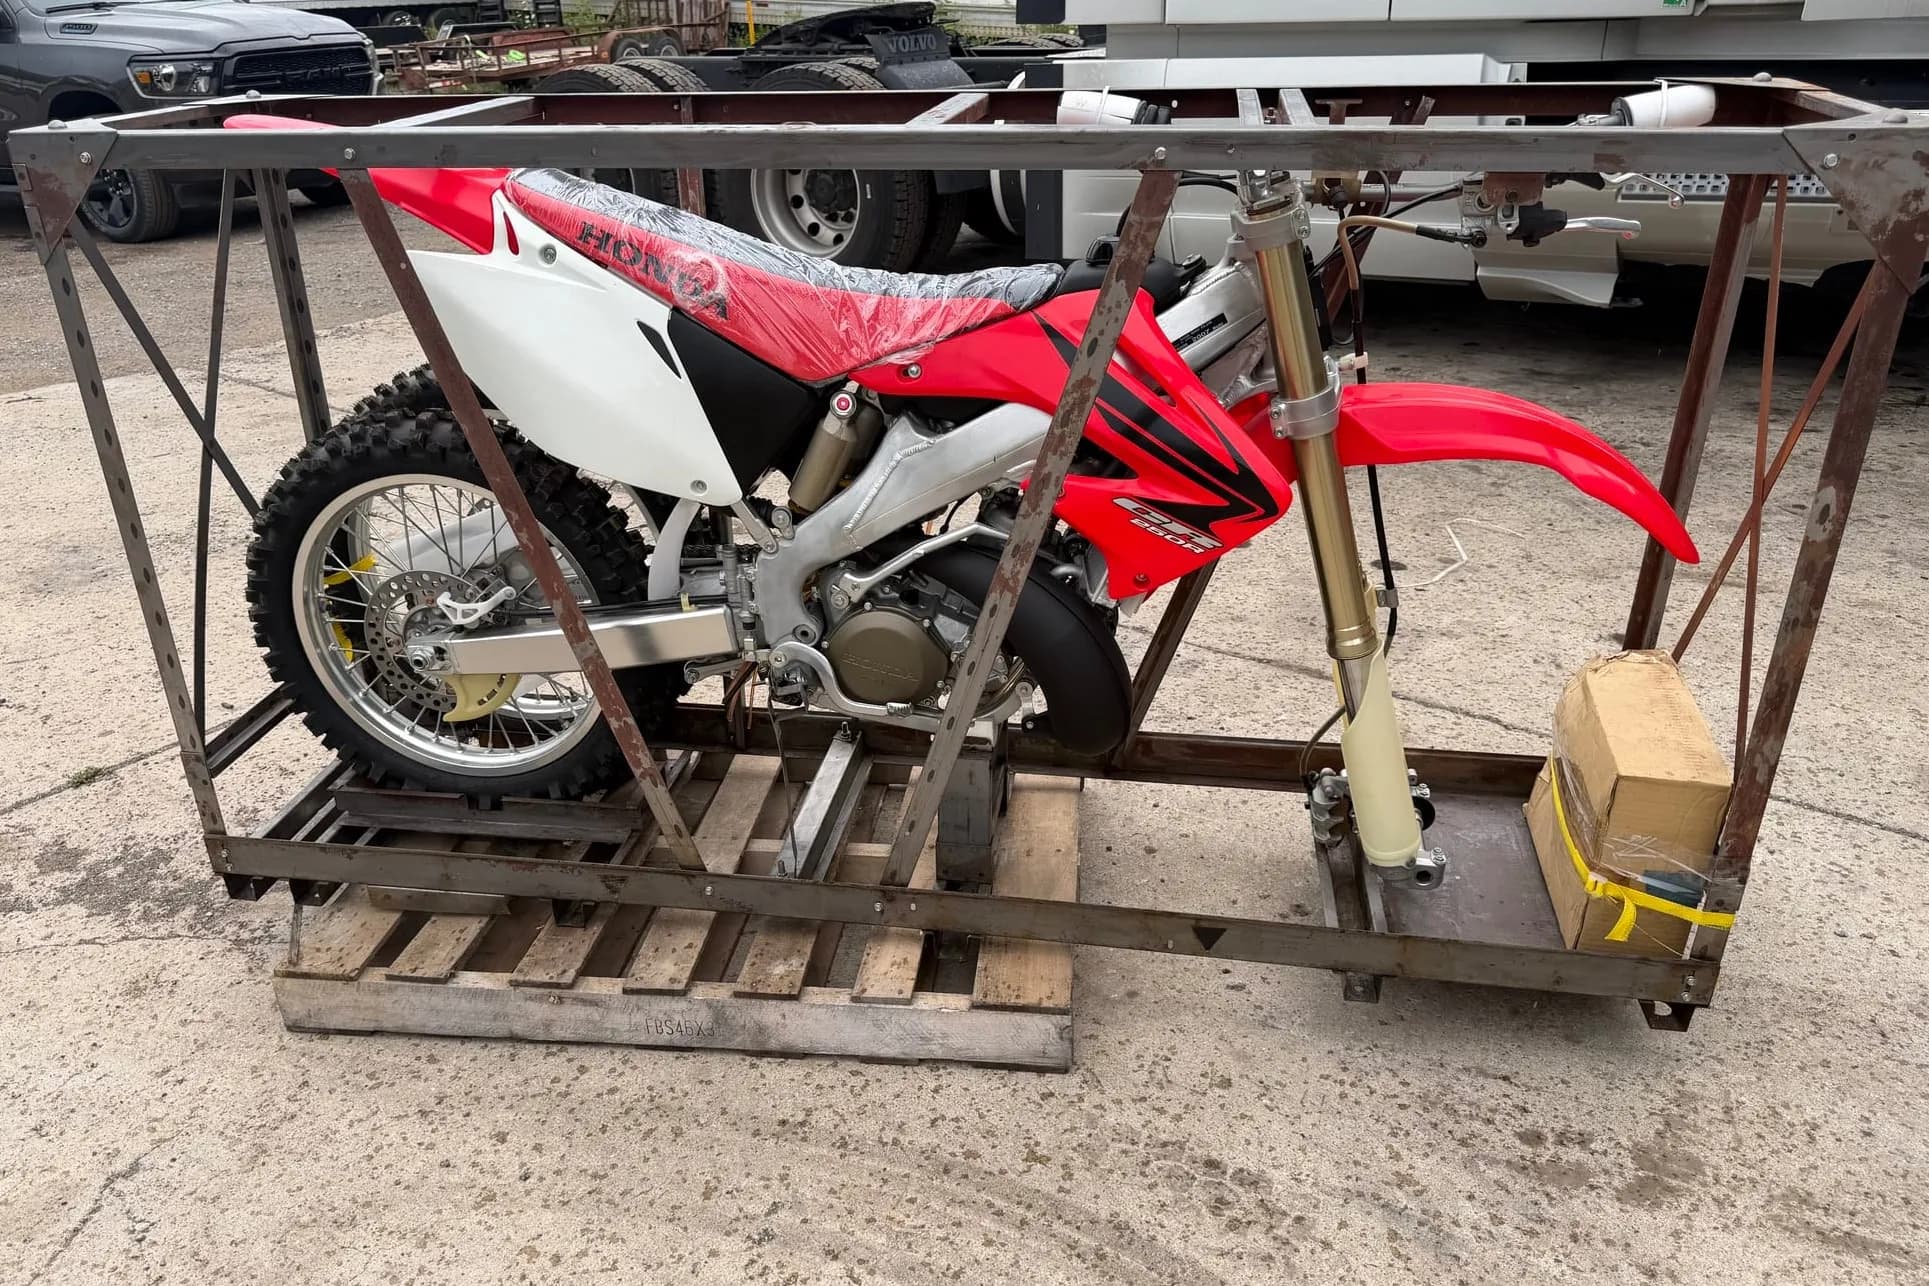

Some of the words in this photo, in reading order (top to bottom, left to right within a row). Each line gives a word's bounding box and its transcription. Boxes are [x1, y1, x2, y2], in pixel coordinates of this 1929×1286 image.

[888, 33, 937, 53] VOLVO
[576, 220, 729, 321] HONDA
[1129, 517, 1206, 554] 250R
